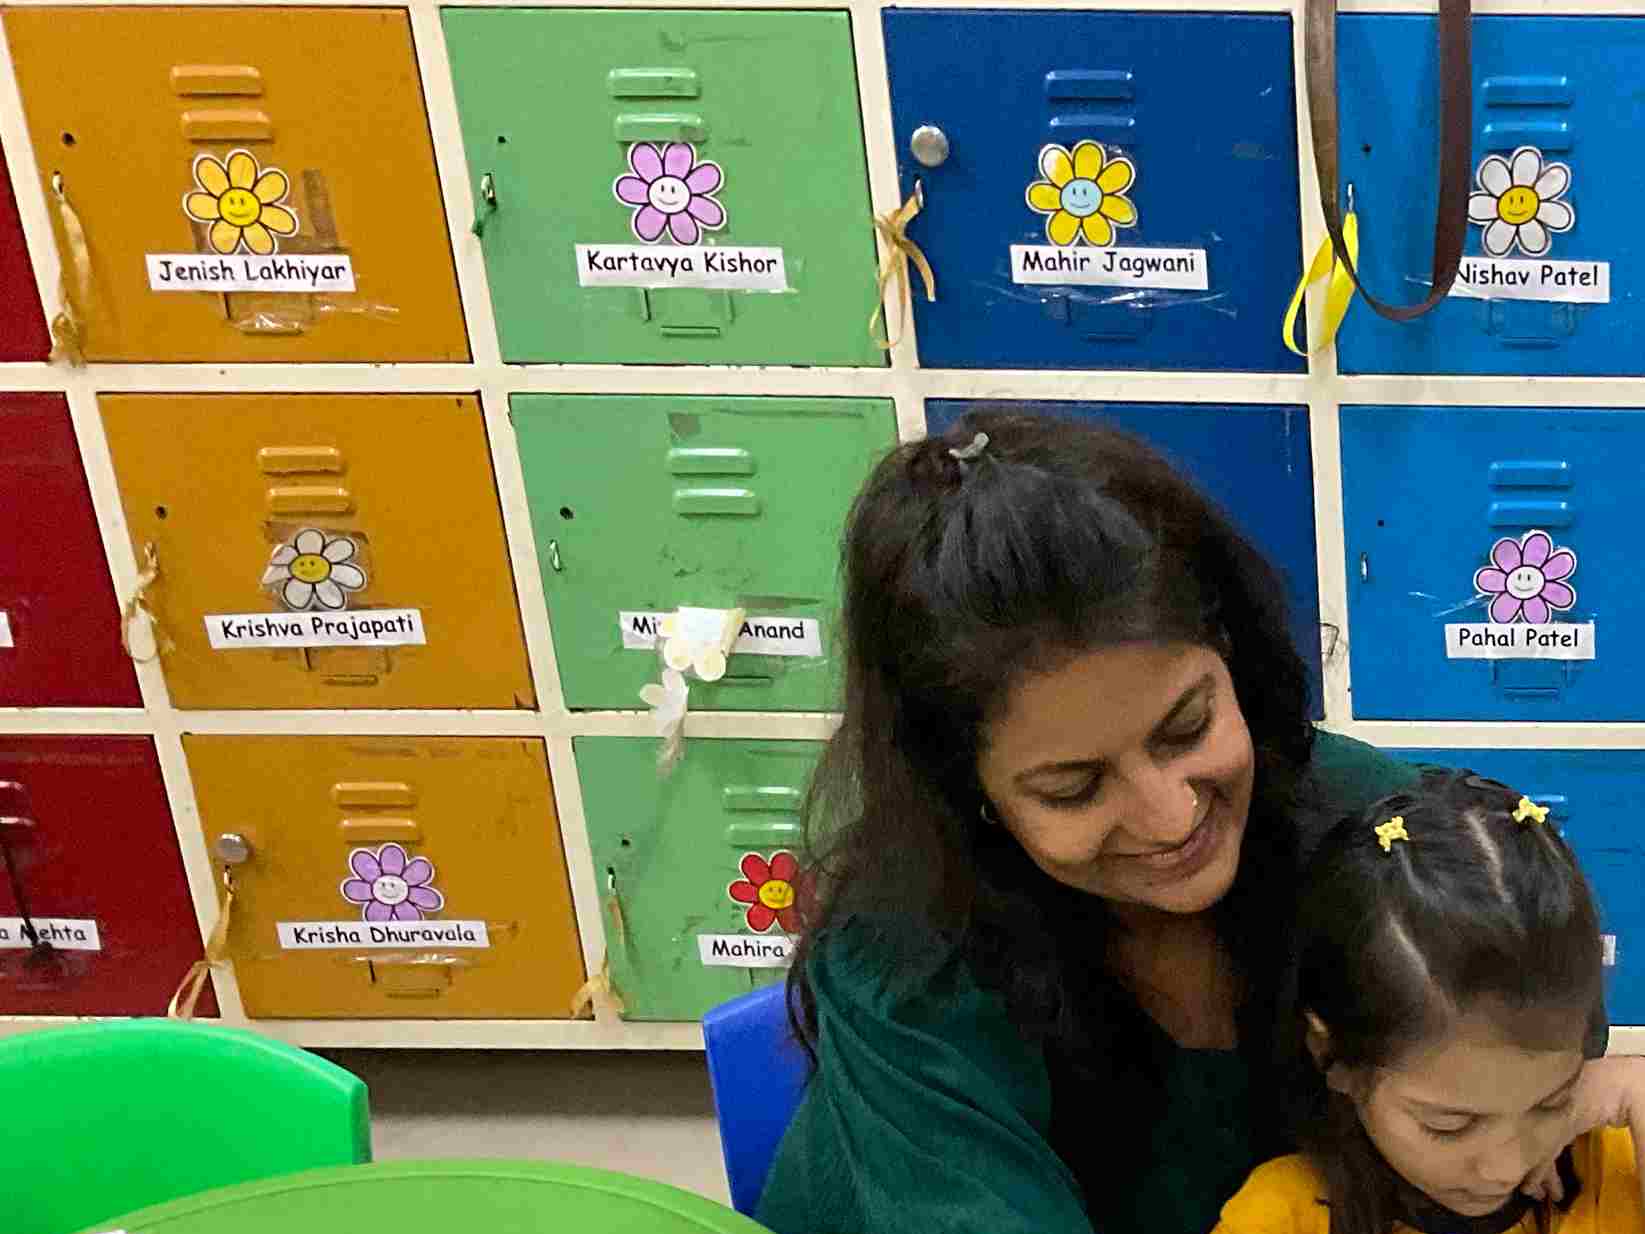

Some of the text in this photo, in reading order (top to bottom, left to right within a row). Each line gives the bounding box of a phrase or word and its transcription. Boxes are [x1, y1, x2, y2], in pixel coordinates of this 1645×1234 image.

[159, 260, 345, 285] Jenish Lakhiyar
[586, 252, 777, 279] Kartavya Kishor
[1023, 251, 1196, 277] Mahir Jagwani
[1540, 263, 1599, 286] Patel
[222, 616, 414, 643] Krishva Prajapati
[738, 620, 804, 641] Anand
[1460, 628, 1579, 649] Pahal Patel
[293, 928, 360, 944] Krisha
[712, 942, 785, 958] Mahira
